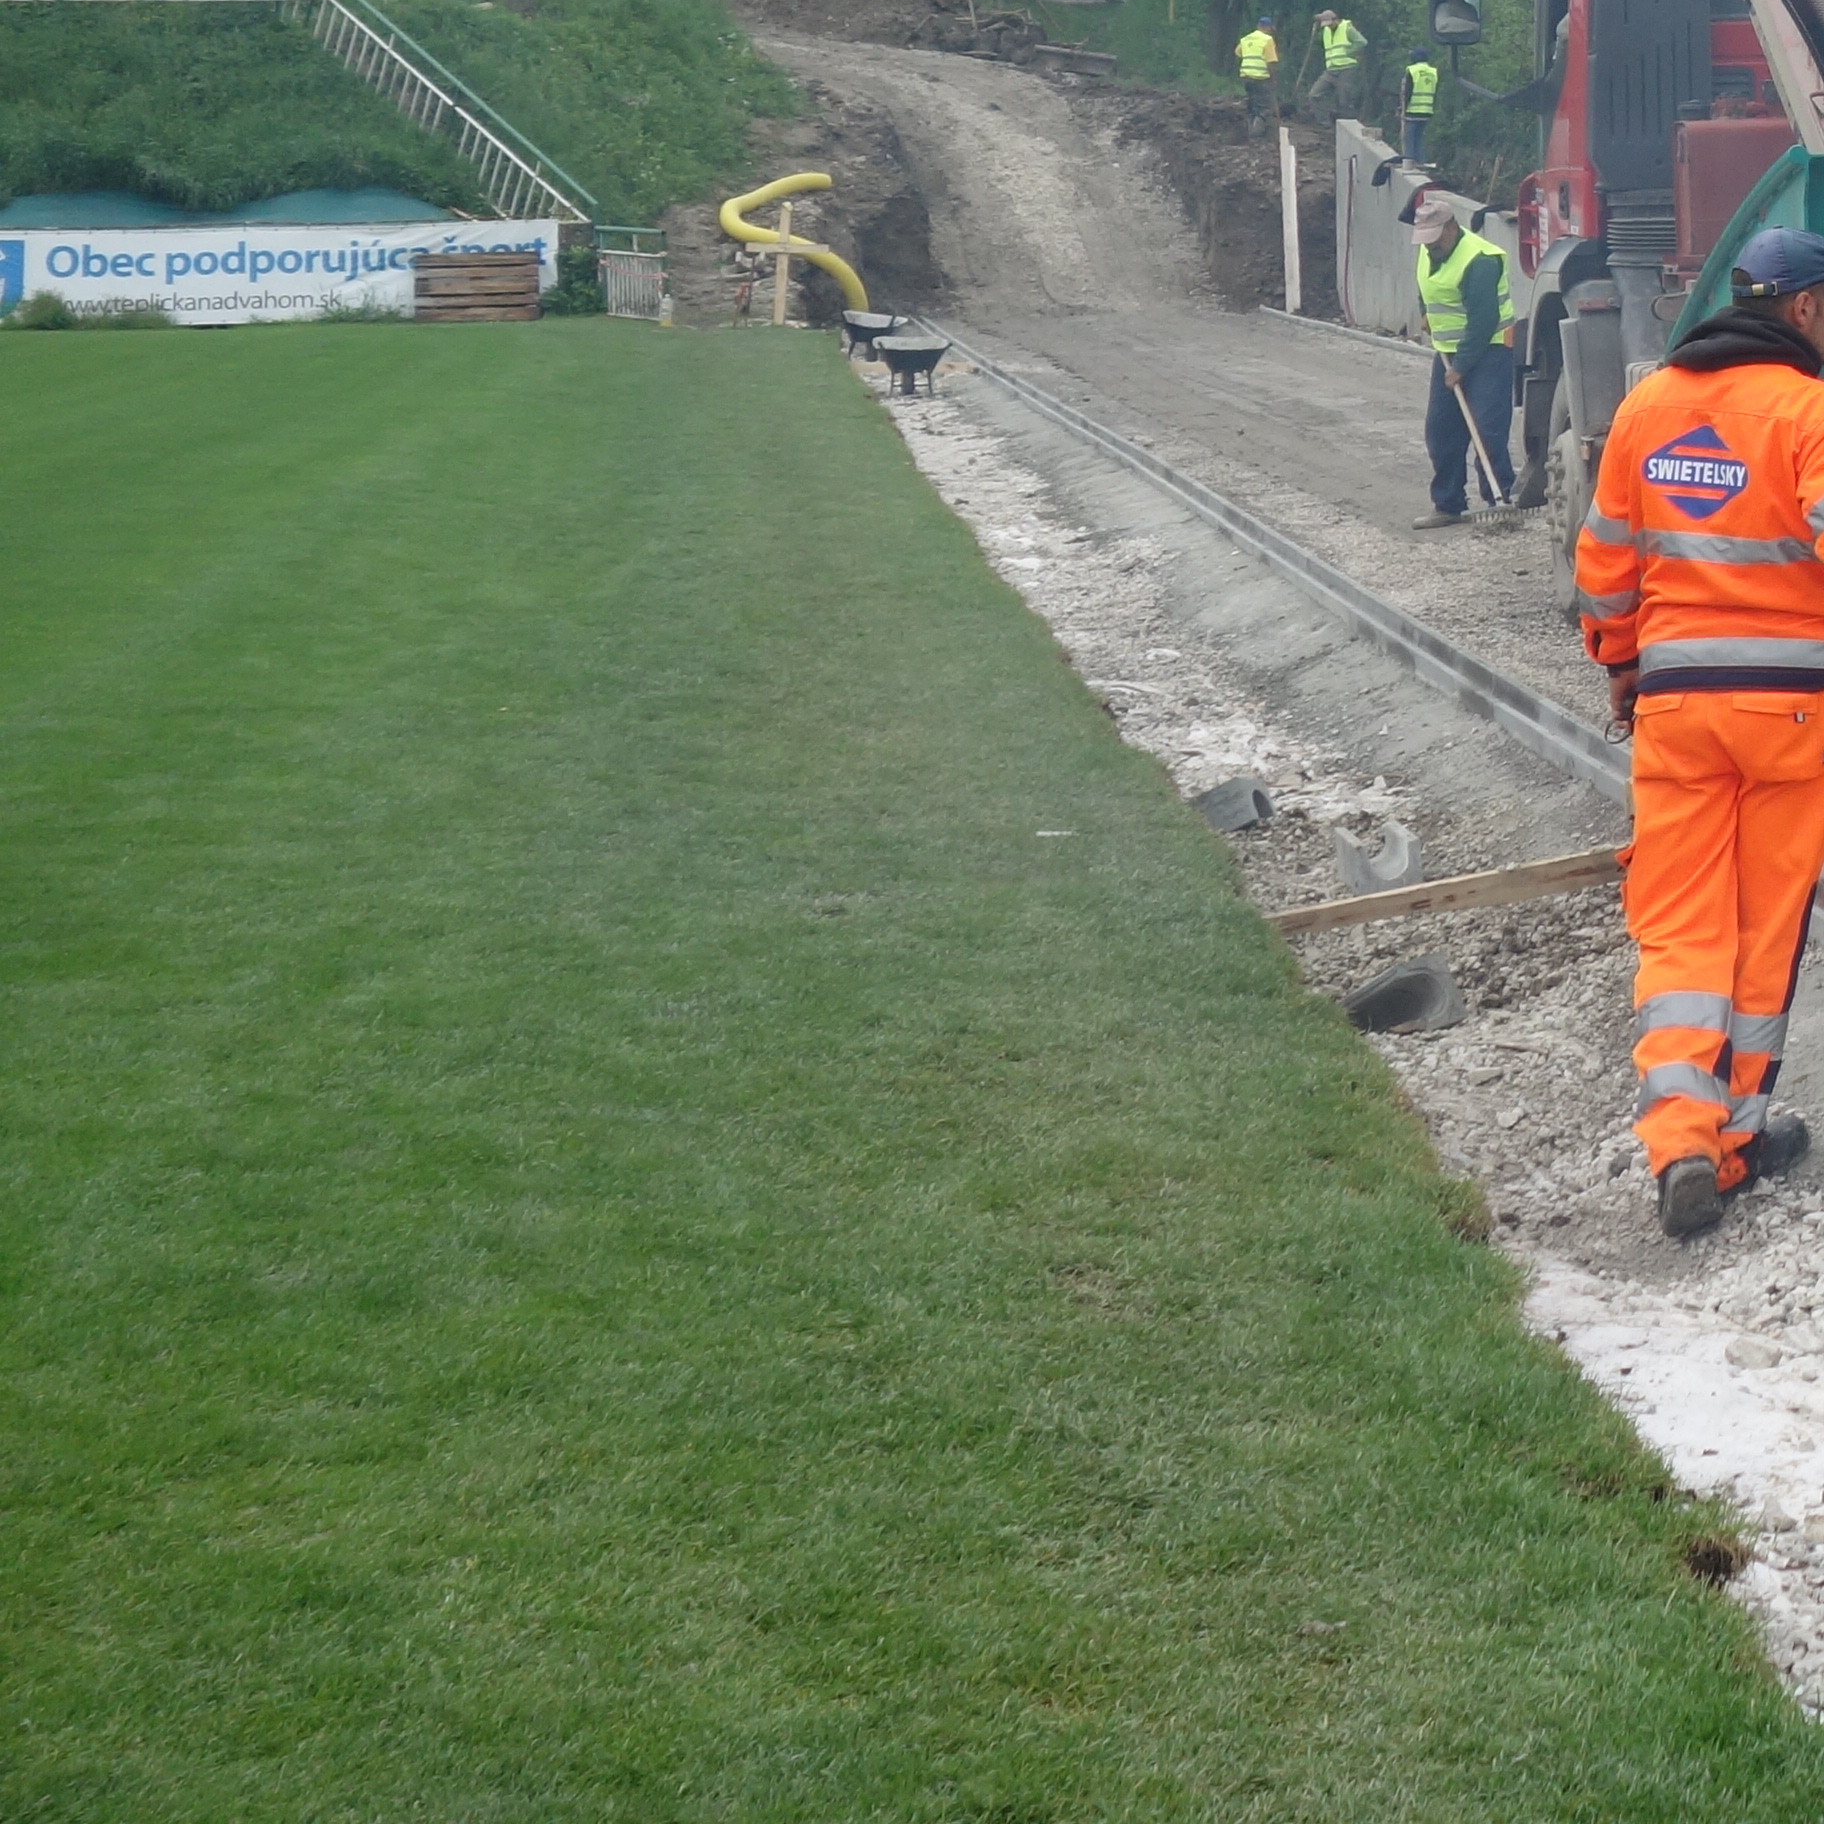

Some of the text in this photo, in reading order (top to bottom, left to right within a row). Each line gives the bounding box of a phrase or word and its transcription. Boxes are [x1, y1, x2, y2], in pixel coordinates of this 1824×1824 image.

[46, 244, 156, 278] Obec
[62, 289, 342, 314] ww.teplickanadvahom.sk
[1647, 457, 1746, 487] SWIETELSKY
